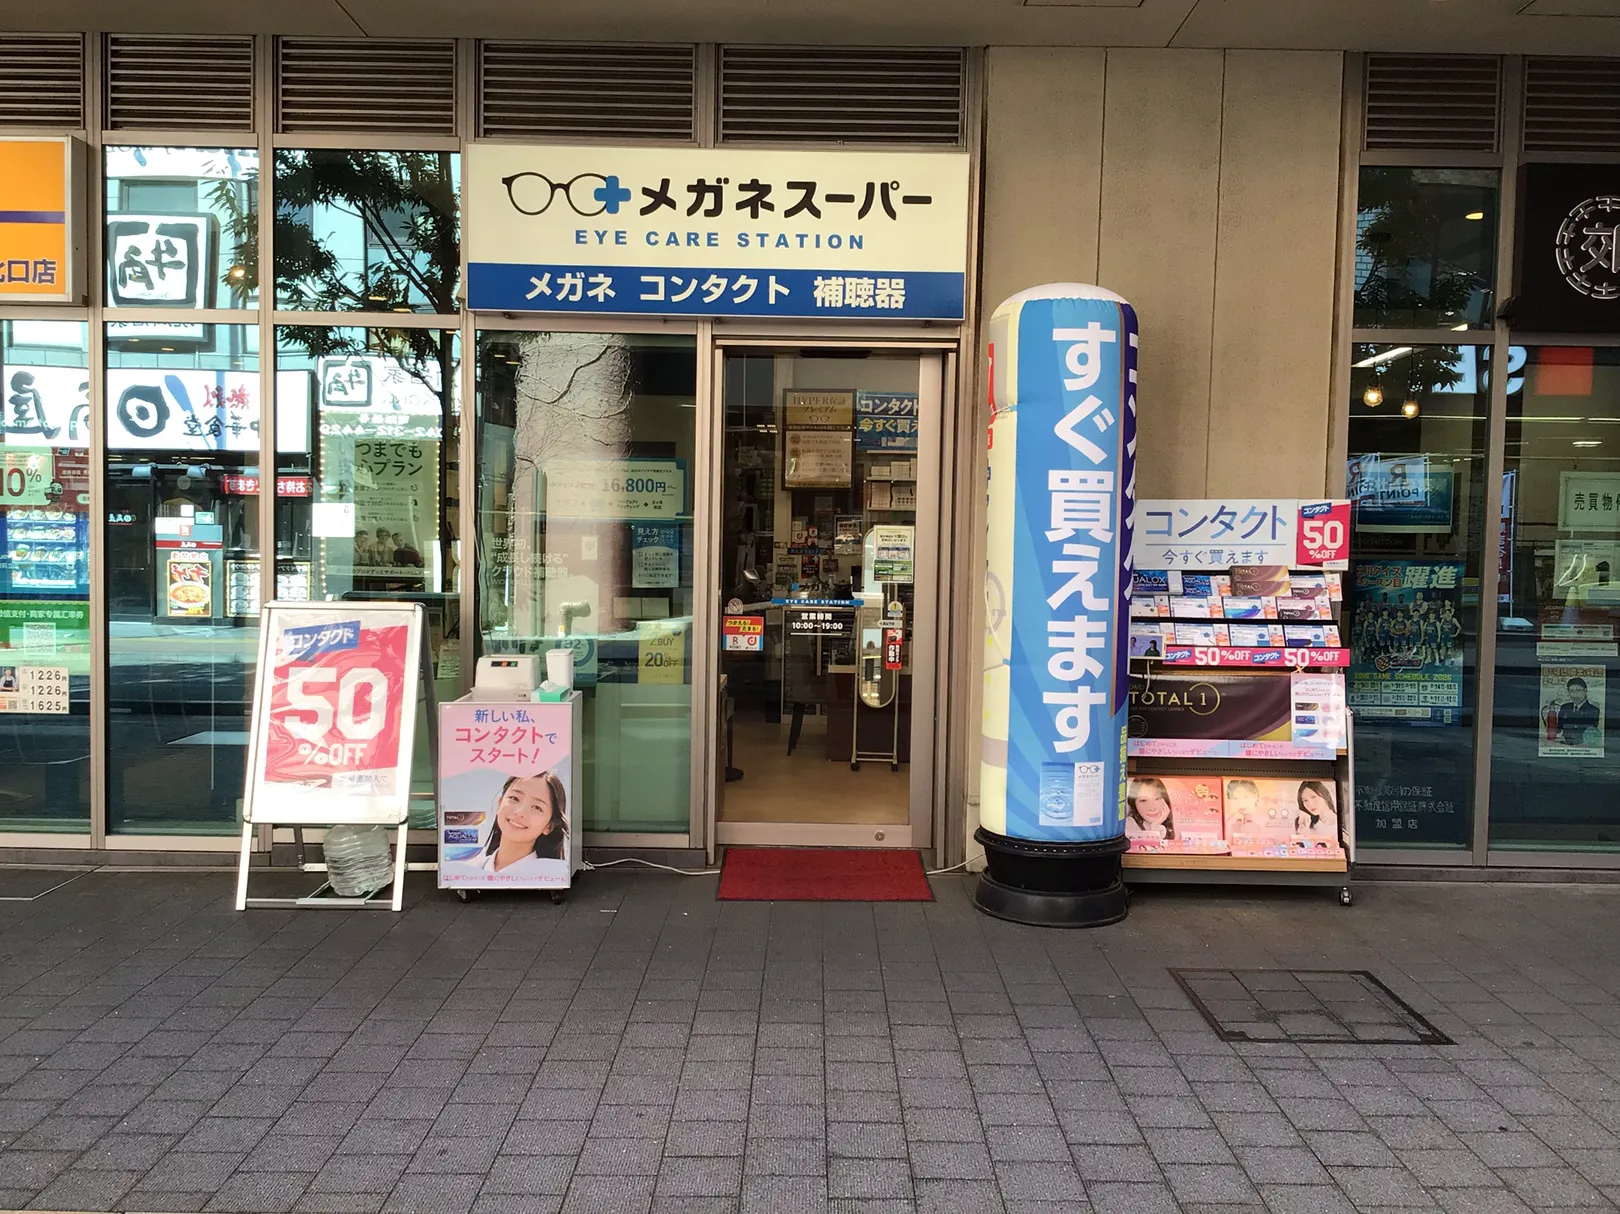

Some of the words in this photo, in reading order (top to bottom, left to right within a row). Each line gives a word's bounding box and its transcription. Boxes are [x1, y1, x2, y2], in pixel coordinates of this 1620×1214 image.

[640, 177, 932, 221] メガネスーパー
[575, 230, 628, 245] EYE
[646, 231, 720, 247] CARE
[737, 233, 866, 250] STATION
[0, 259, 57, 284] 口店
[525, 272, 616, 302] メガネ
[639, 274, 791, 305] コンタクト
[813, 276, 906, 310] 補聴器
[1145, 504, 1288, 541] コンタクト
[1303, 520, 1344, 549] 50
[1043, 321, 1117, 755] すぐ買えます
[1162, 548, 1269, 565] 今すぐ買えます
[1309, 549, 1337, 560] %OFF
[283, 666, 389, 741] 50
[1128, 691, 1194, 706] TOTAL
[474, 709, 537, 724] 新しい私、
[455, 725, 558, 745] コンタクトで
[297, 743, 369, 767] %OFF
